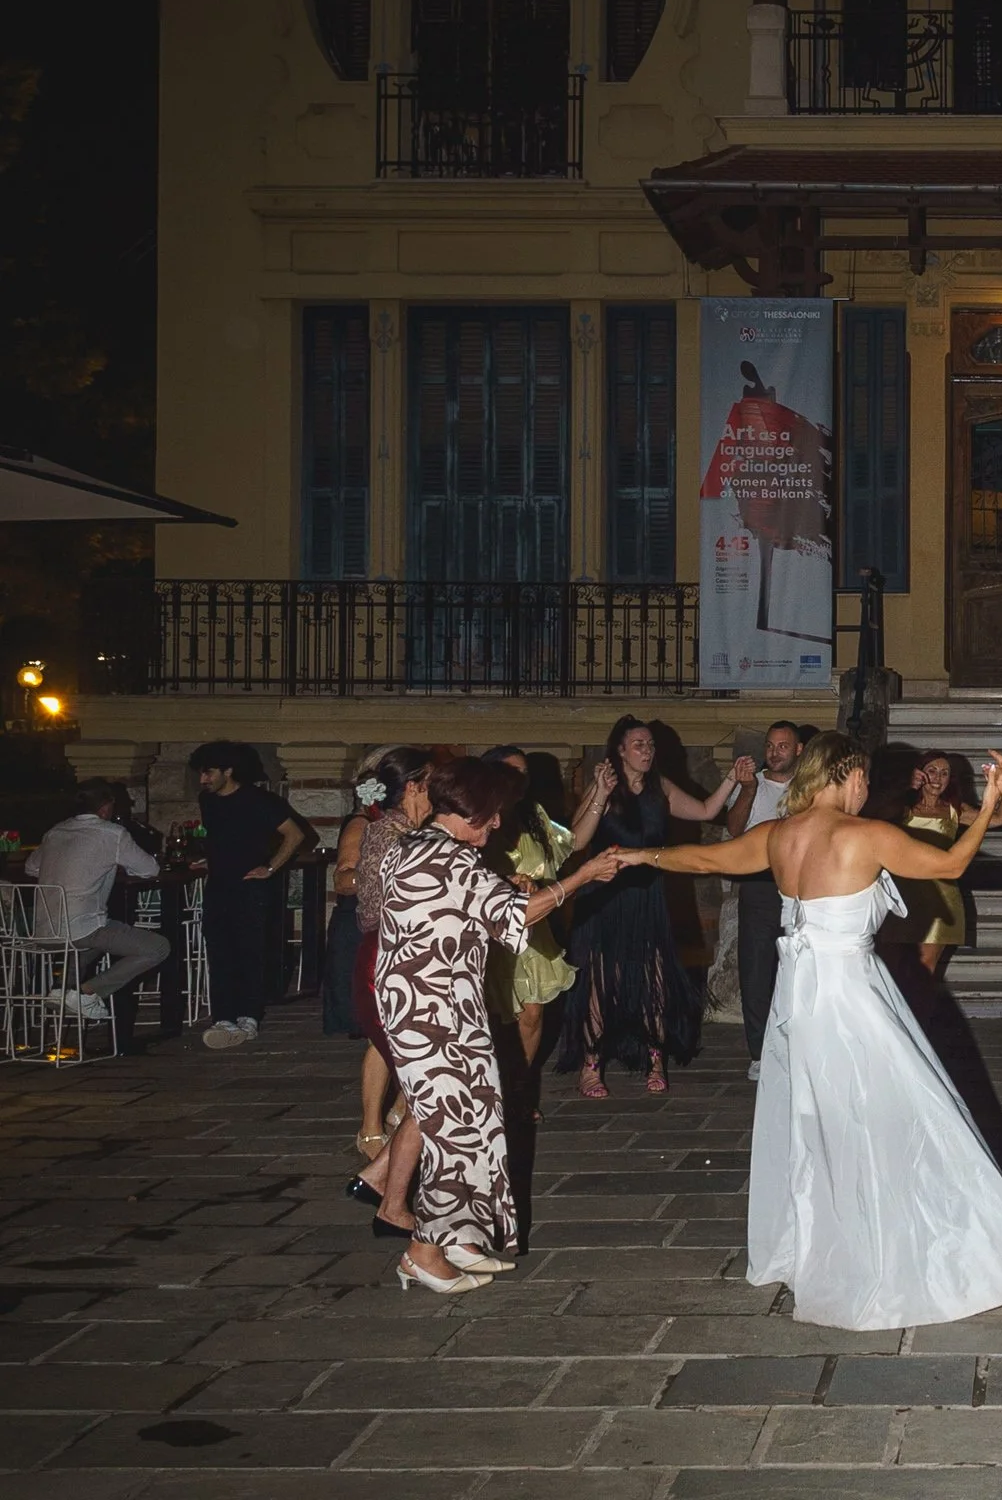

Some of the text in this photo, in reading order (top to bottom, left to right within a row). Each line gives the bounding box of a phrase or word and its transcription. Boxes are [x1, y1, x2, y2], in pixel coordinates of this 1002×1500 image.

[731, 311, 821, 319] CITY OF THESSALONIKI
[720, 424, 790, 441] Art as a
[720, 443, 795, 459] language
[720, 459, 812, 476] of dialogue:
[720, 476, 813, 487] Women Artists
[720, 488, 811, 499] of the Balkans
